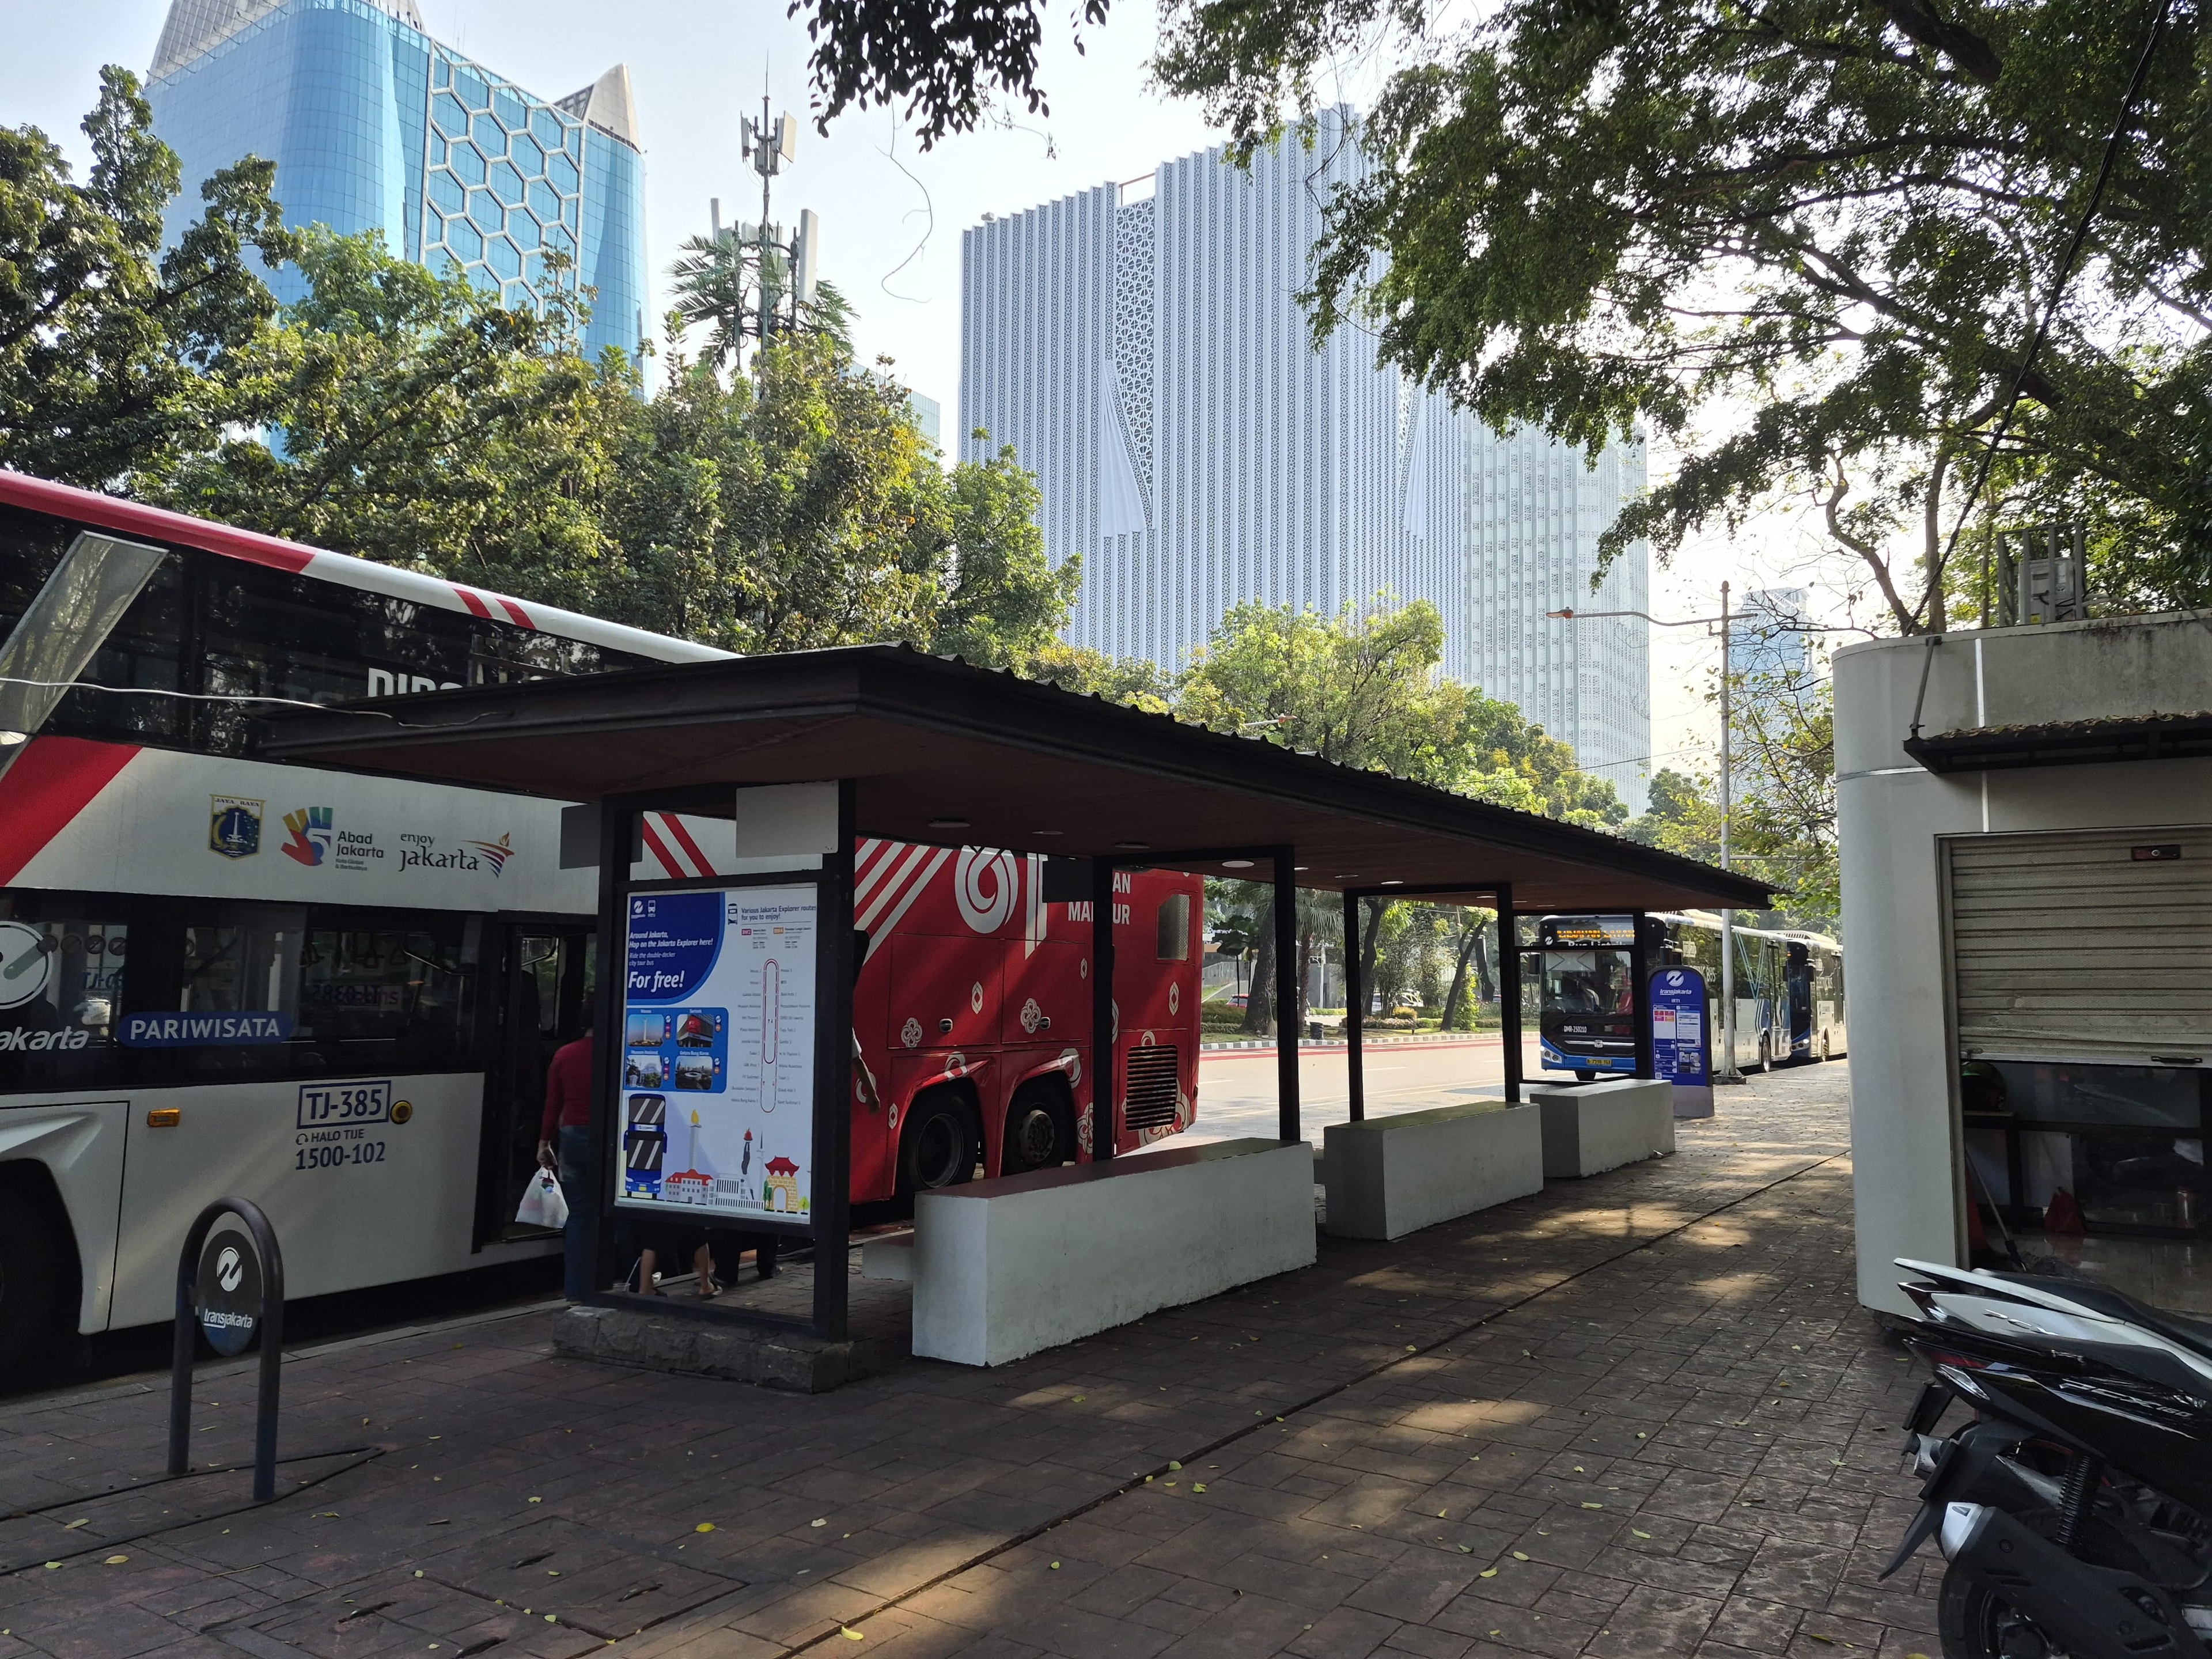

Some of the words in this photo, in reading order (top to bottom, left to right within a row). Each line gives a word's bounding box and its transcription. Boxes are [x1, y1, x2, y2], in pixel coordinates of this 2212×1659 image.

[338, 831, 373, 844] Abad
[400, 833, 435, 847] enjoy
[336, 843, 384, 859] Jakarta
[398, 846, 480, 872] jakarta
[1112, 872, 1131, 894] AN
[629, 931, 649, 939] Around
[649, 931, 669, 939] Jakarta,
[629, 941, 639, 949] Hop
[657, 940, 676, 948] Jakarta
[677, 938, 699, 948] Explorer
[699, 938, 714, 946] here!
[628, 971, 651, 988] For
[650, 970, 685, 993] free!
[0, 1025, 89, 1051] akarta
[130, 1017, 281, 1040] PARIWISATA
[306, 1089, 382, 1120] TJ-385
[310, 1130, 341, 1143] HALO
[343, 1128, 365, 1140] TIJE
[295, 1141, 386, 1170] 1500-102
[203, 1308, 253, 1329] transjakarta
